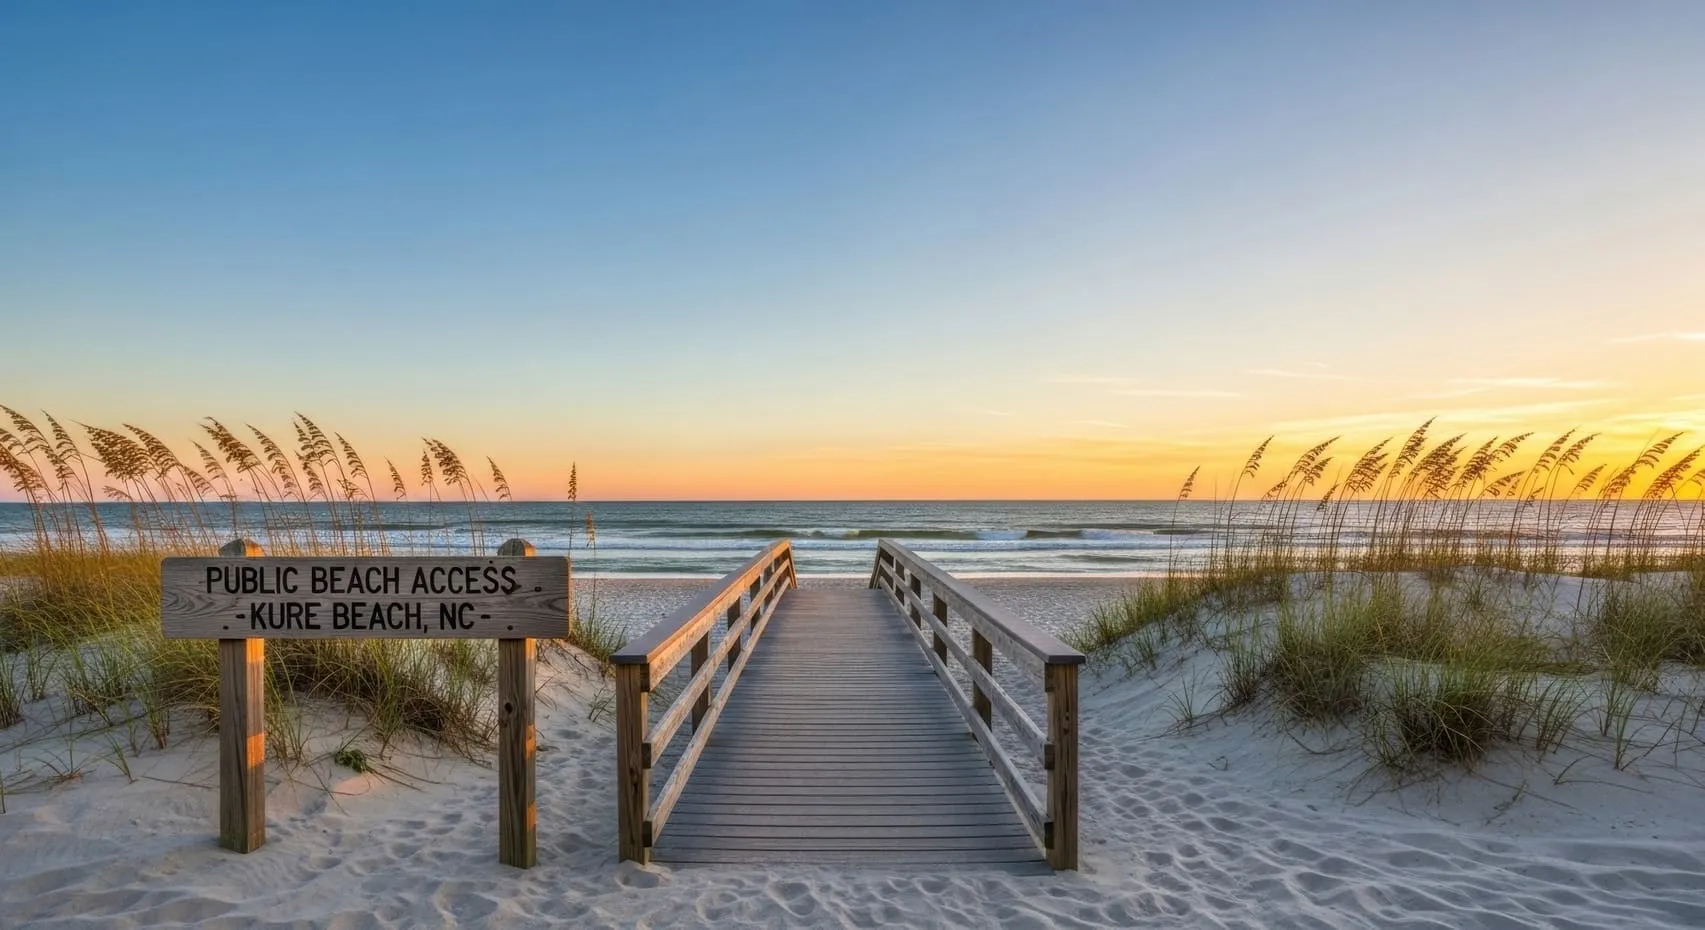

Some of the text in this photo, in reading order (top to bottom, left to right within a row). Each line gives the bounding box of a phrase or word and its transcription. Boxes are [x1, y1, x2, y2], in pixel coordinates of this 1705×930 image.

[206, 566, 518, 595] PUBLIC BEACH ACCESS
[332, 602, 429, 633] BEACH,
